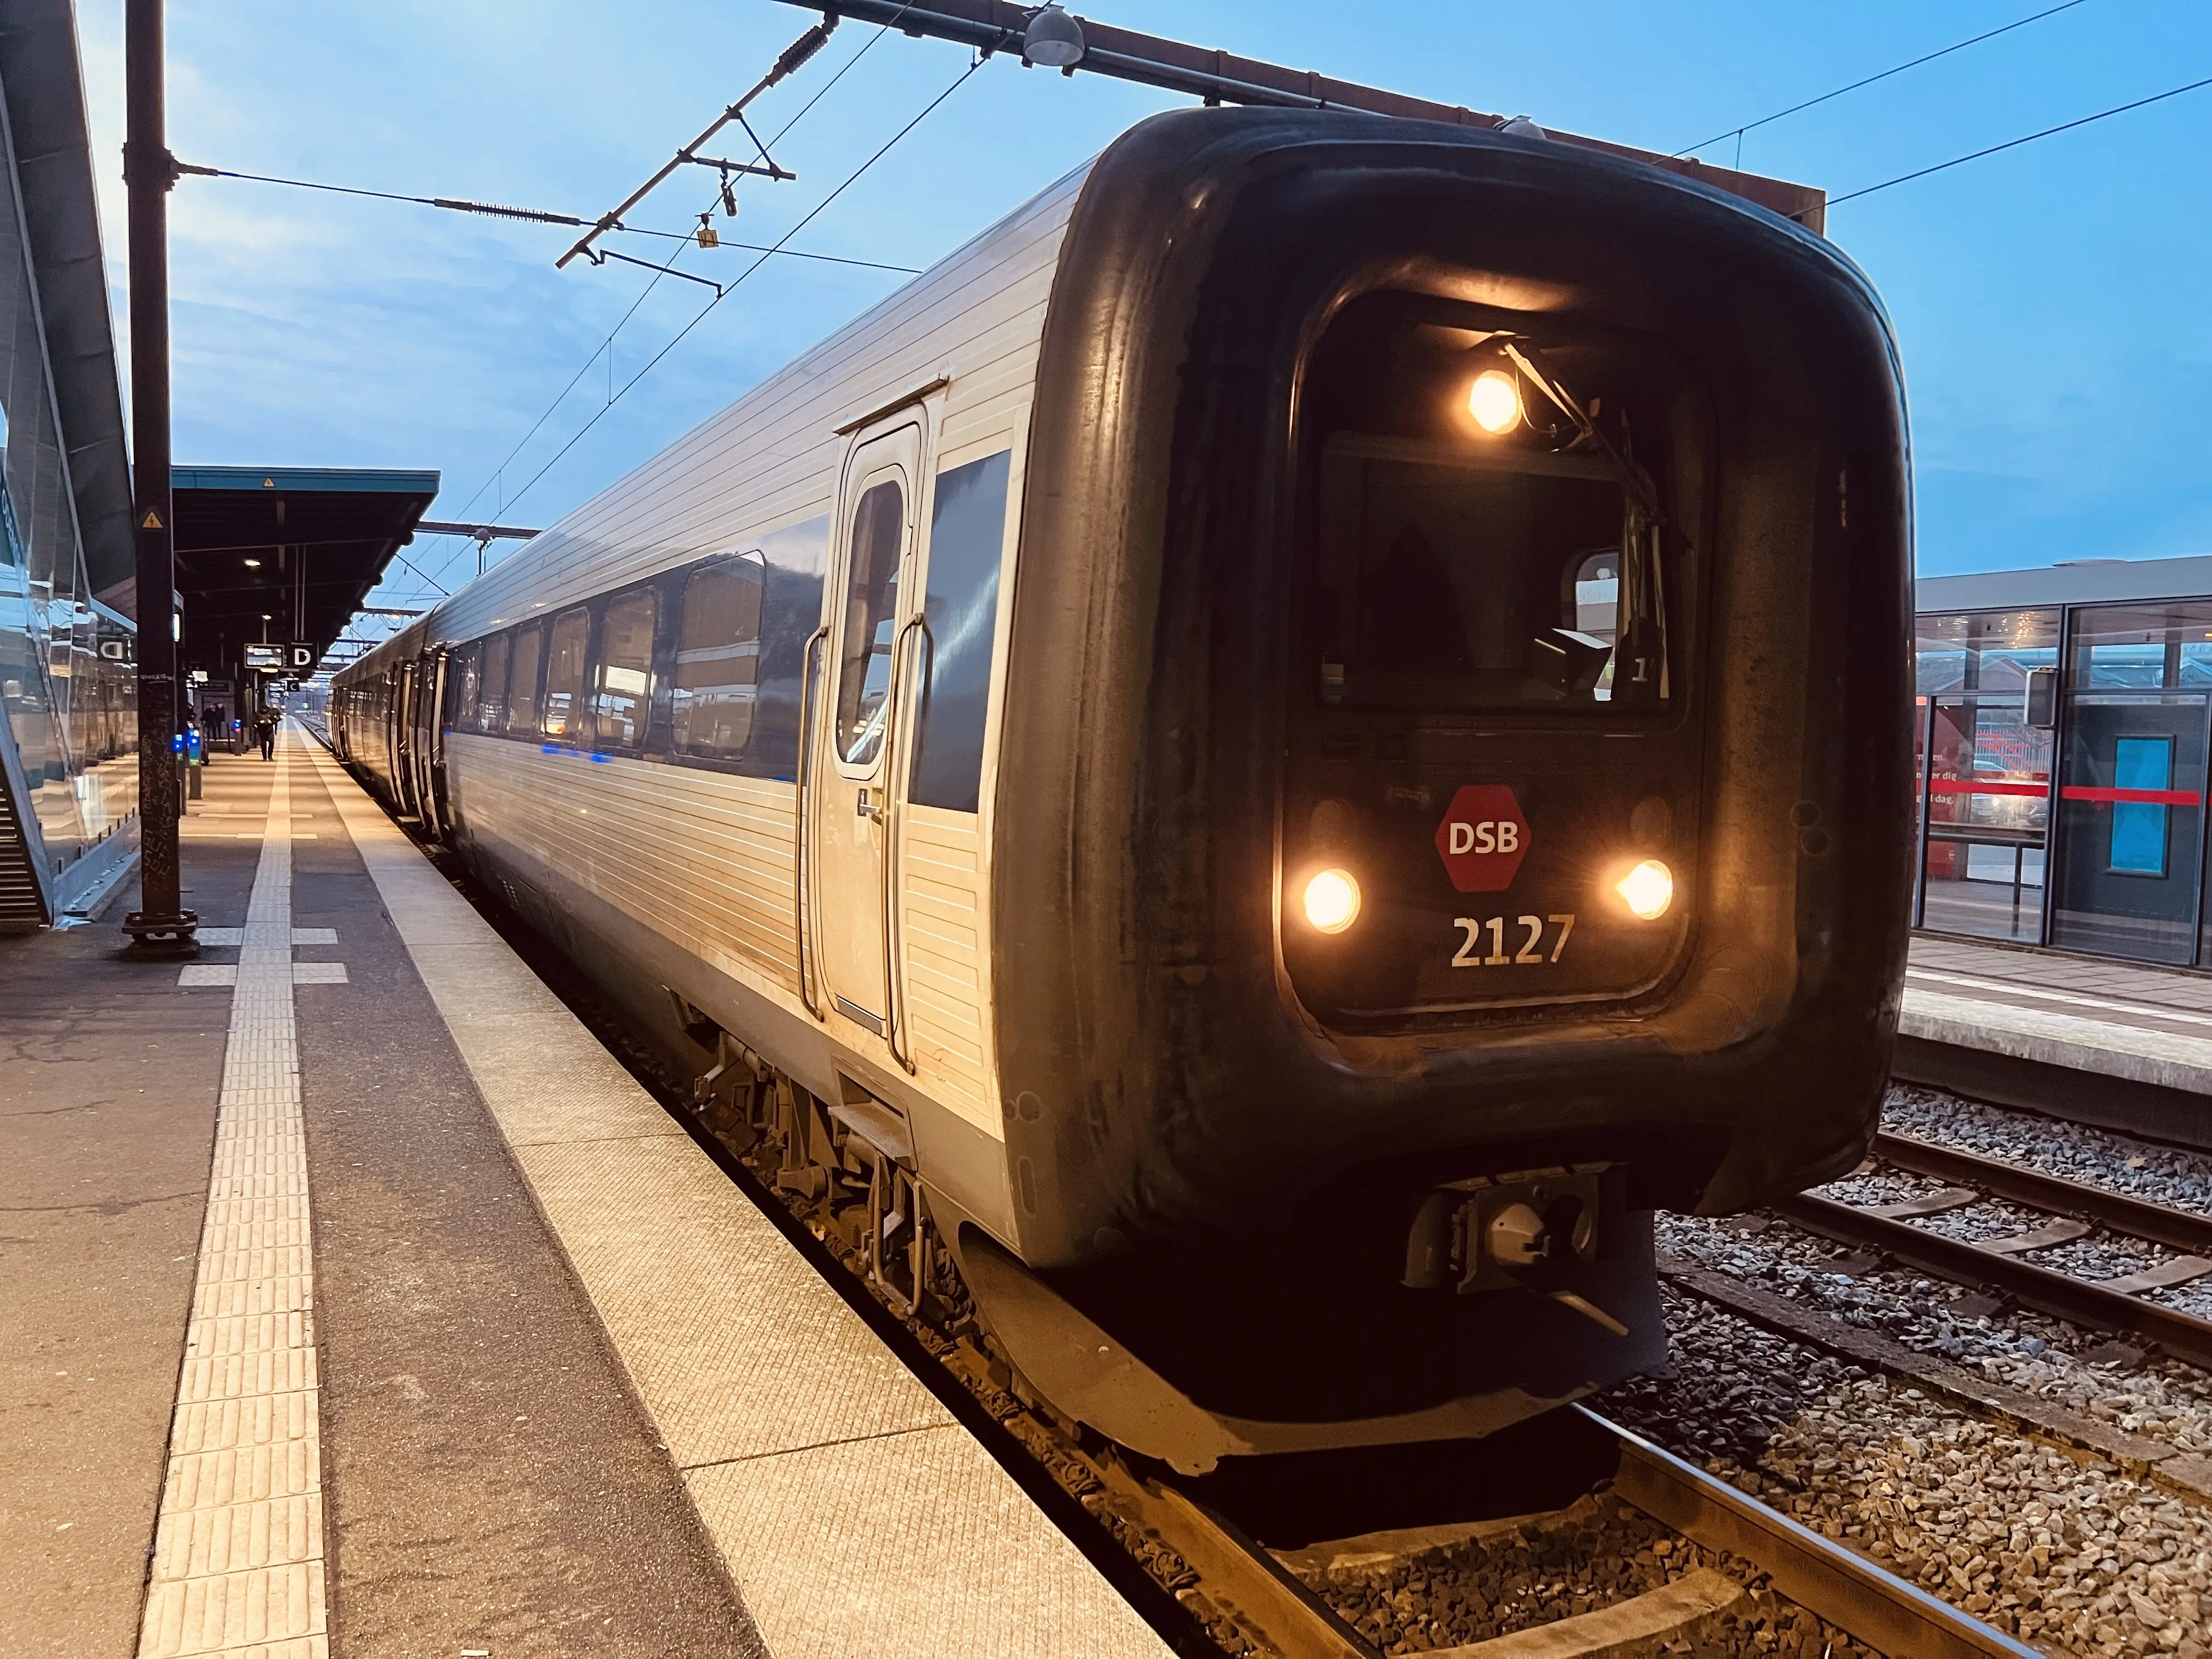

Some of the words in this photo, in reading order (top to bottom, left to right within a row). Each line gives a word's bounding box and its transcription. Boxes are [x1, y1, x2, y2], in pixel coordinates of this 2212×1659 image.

[294, 648, 311, 665] D
[1632, 658, 1647, 682] 1
[1942, 771, 1957, 782] dig
[1449, 821, 1519, 855] DSB
[1451, 913, 1575, 967] 2127
